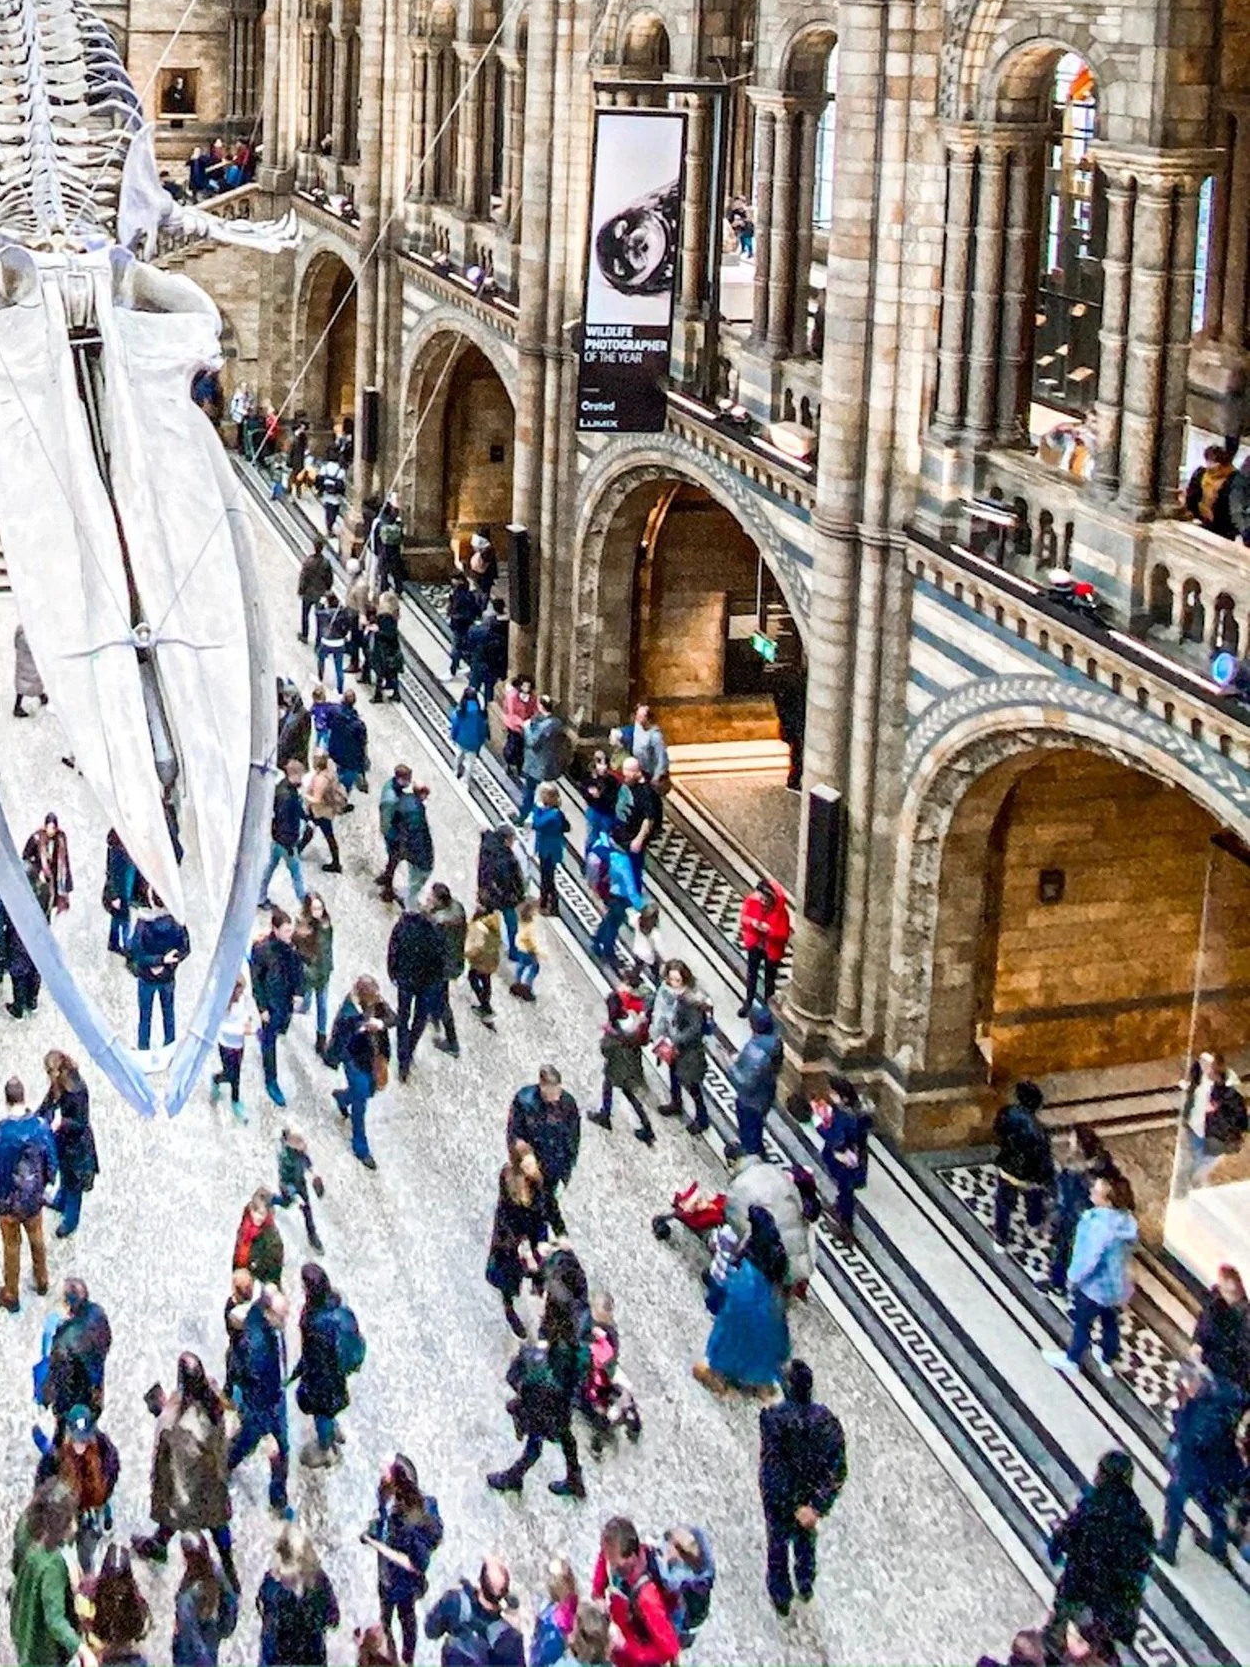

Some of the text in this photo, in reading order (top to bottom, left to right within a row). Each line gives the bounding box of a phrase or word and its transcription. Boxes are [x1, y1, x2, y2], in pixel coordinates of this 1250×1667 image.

[585, 325, 633, 337] WILDLIFE
[584, 338, 668, 352] PHOTOGRAPHER
[583, 351, 643, 364] OF THE YEAR
